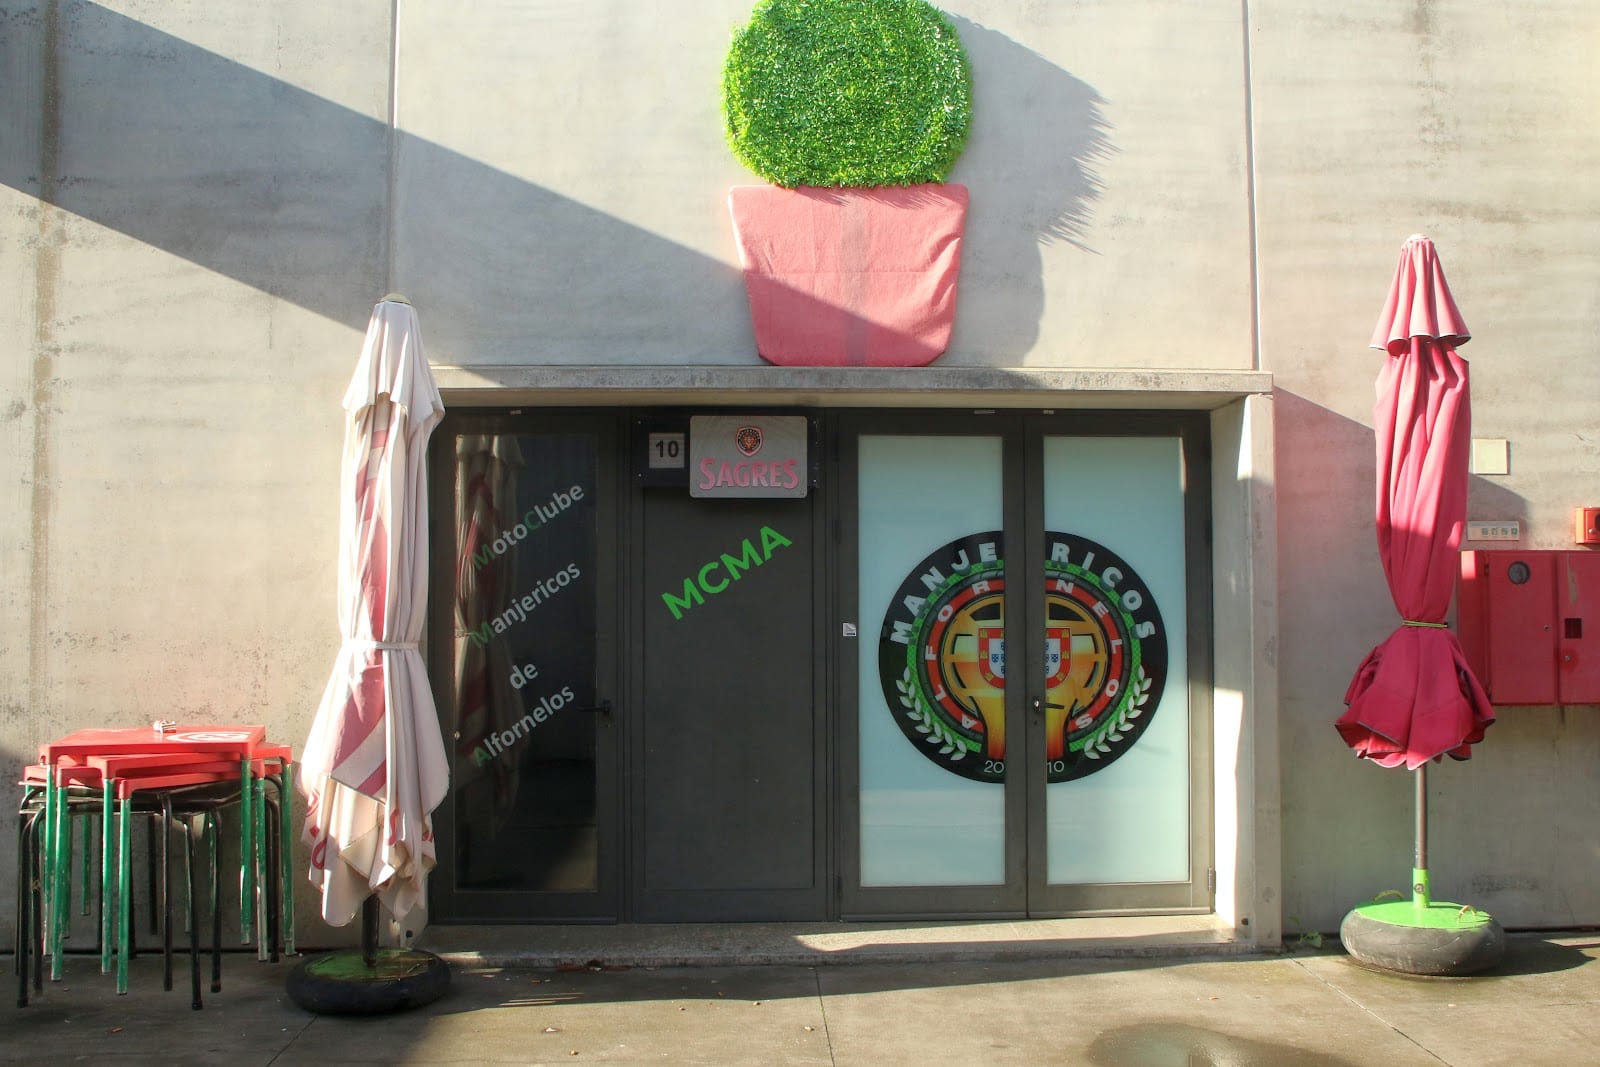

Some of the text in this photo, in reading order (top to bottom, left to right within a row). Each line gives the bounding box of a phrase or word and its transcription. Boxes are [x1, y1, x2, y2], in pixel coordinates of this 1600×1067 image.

[655, 440, 679, 458] 10
[699, 458, 799, 490] SAGRES
[472, 483, 585, 571] MotoClube
[471, 560, 581, 648] Manjericos
[661, 526, 793, 620] MCMA
[509, 661, 539, 690] de
[472, 684, 575, 768] Alfornelos
